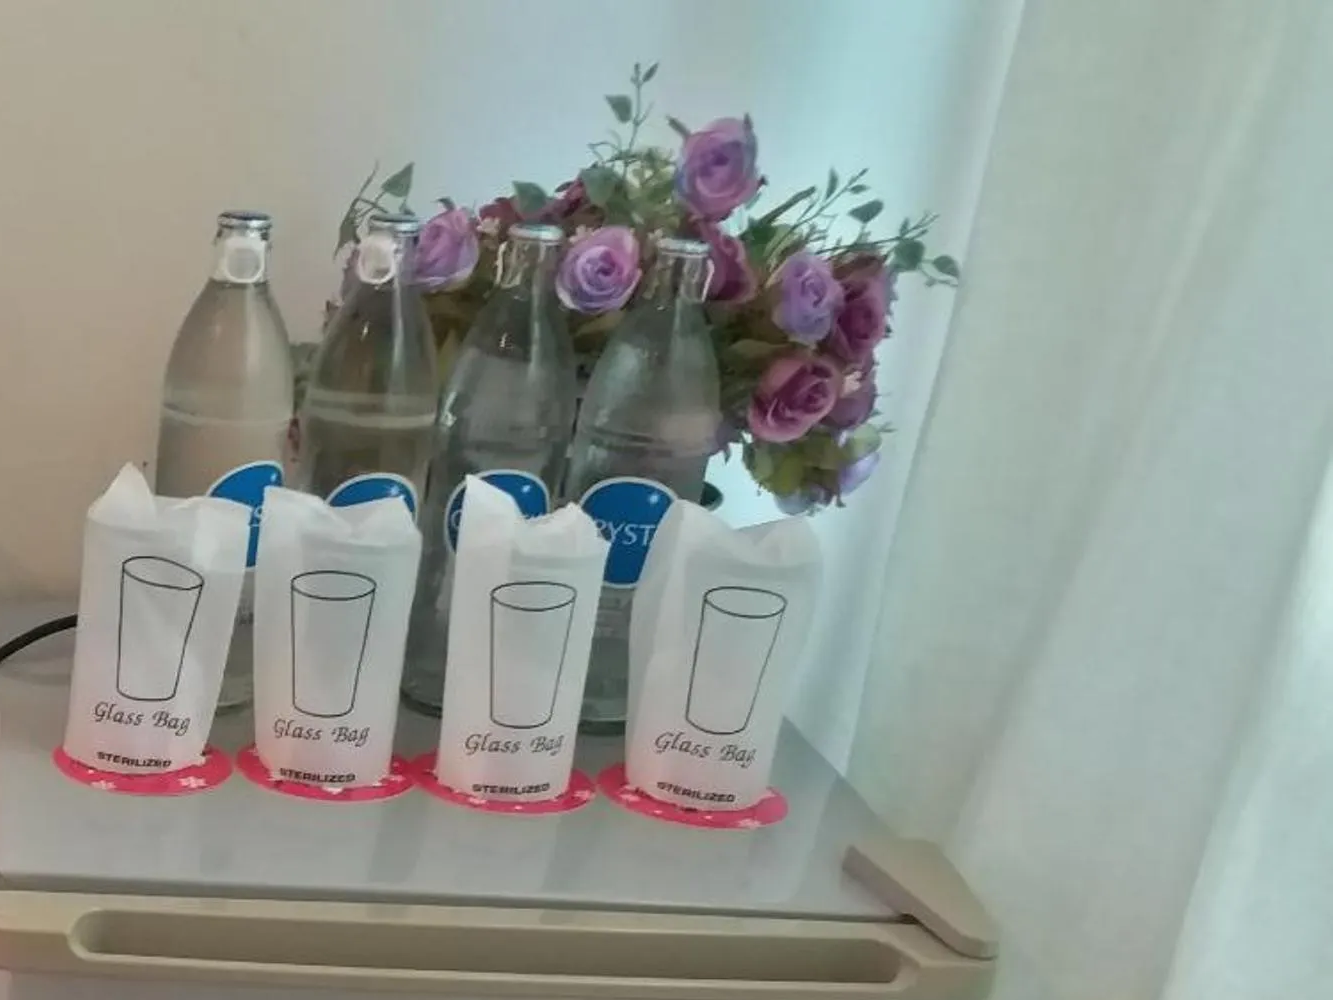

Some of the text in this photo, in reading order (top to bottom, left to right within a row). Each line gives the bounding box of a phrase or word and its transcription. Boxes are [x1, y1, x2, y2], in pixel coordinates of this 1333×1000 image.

[94, 701, 191, 736] Glass Bag
[273, 718, 371, 748] Glass Bag
[465, 733, 565, 756] Glass Bag
[654, 731, 757, 769] Glass Bag
[97, 751, 172, 768] STERILIZED
[279, 767, 356, 783] STERILIZED
[472, 783, 550, 795] STERILIZED
[656, 781, 736, 802] STERILIZED
